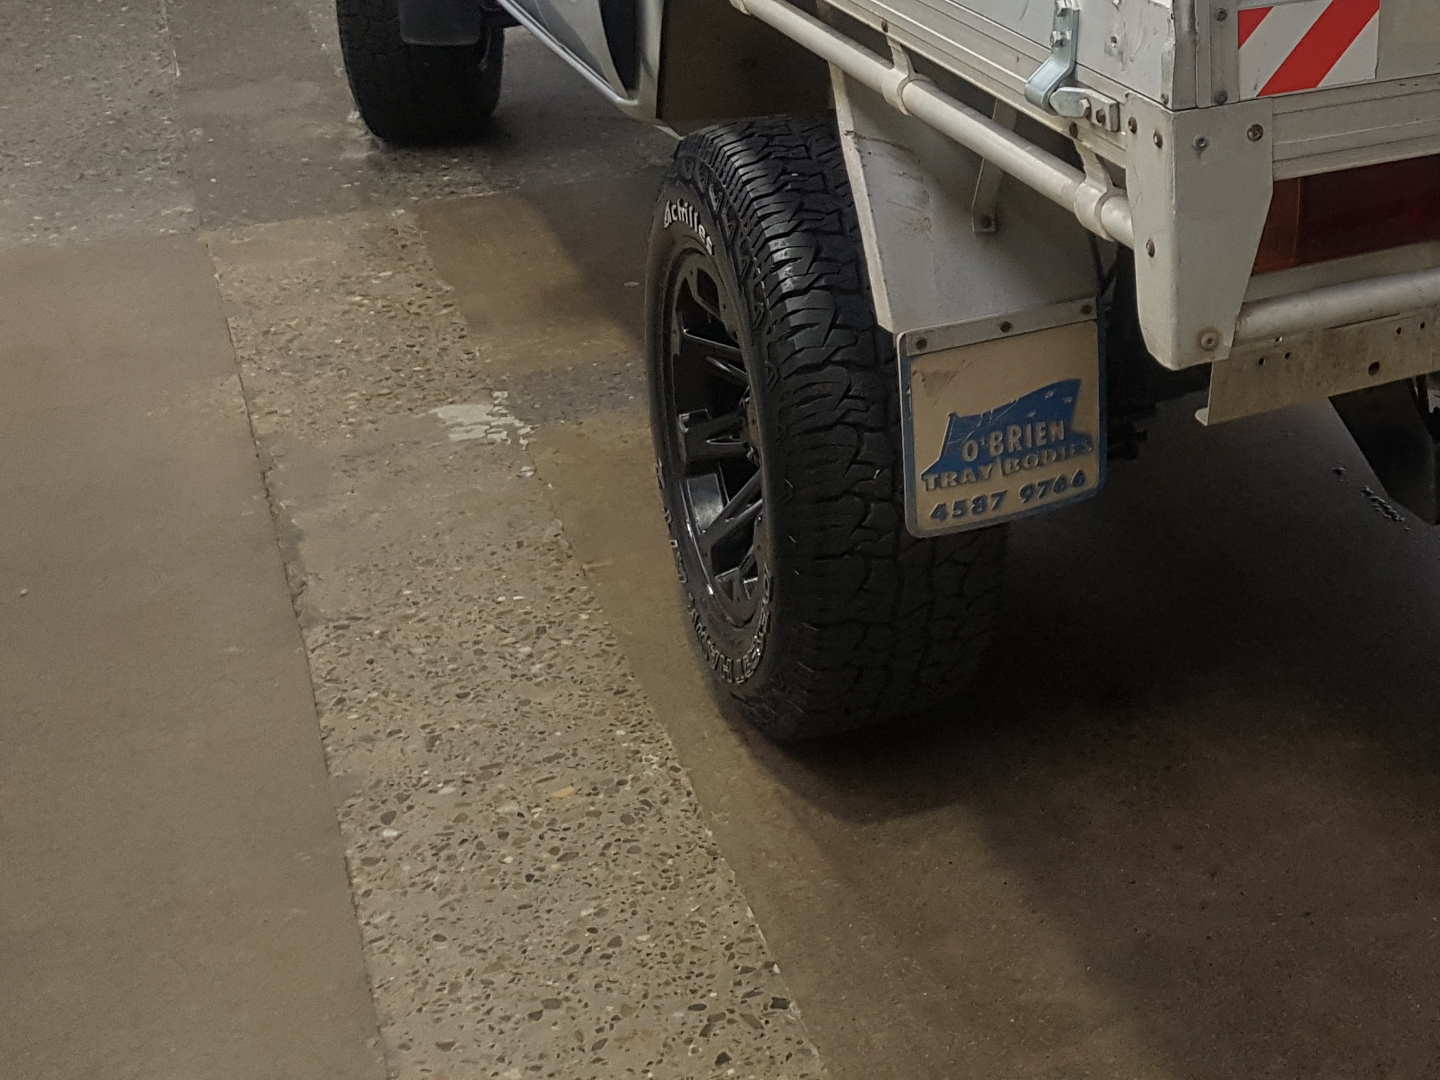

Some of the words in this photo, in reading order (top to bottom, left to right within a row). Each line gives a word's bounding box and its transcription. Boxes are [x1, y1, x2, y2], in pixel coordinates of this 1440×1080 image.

[664, 198, 713, 256] Achilles
[961, 419, 1066, 463] O'BRIEN
[929, 489, 1008, 521] 4587
[1018, 469, 1087, 503] 9766
